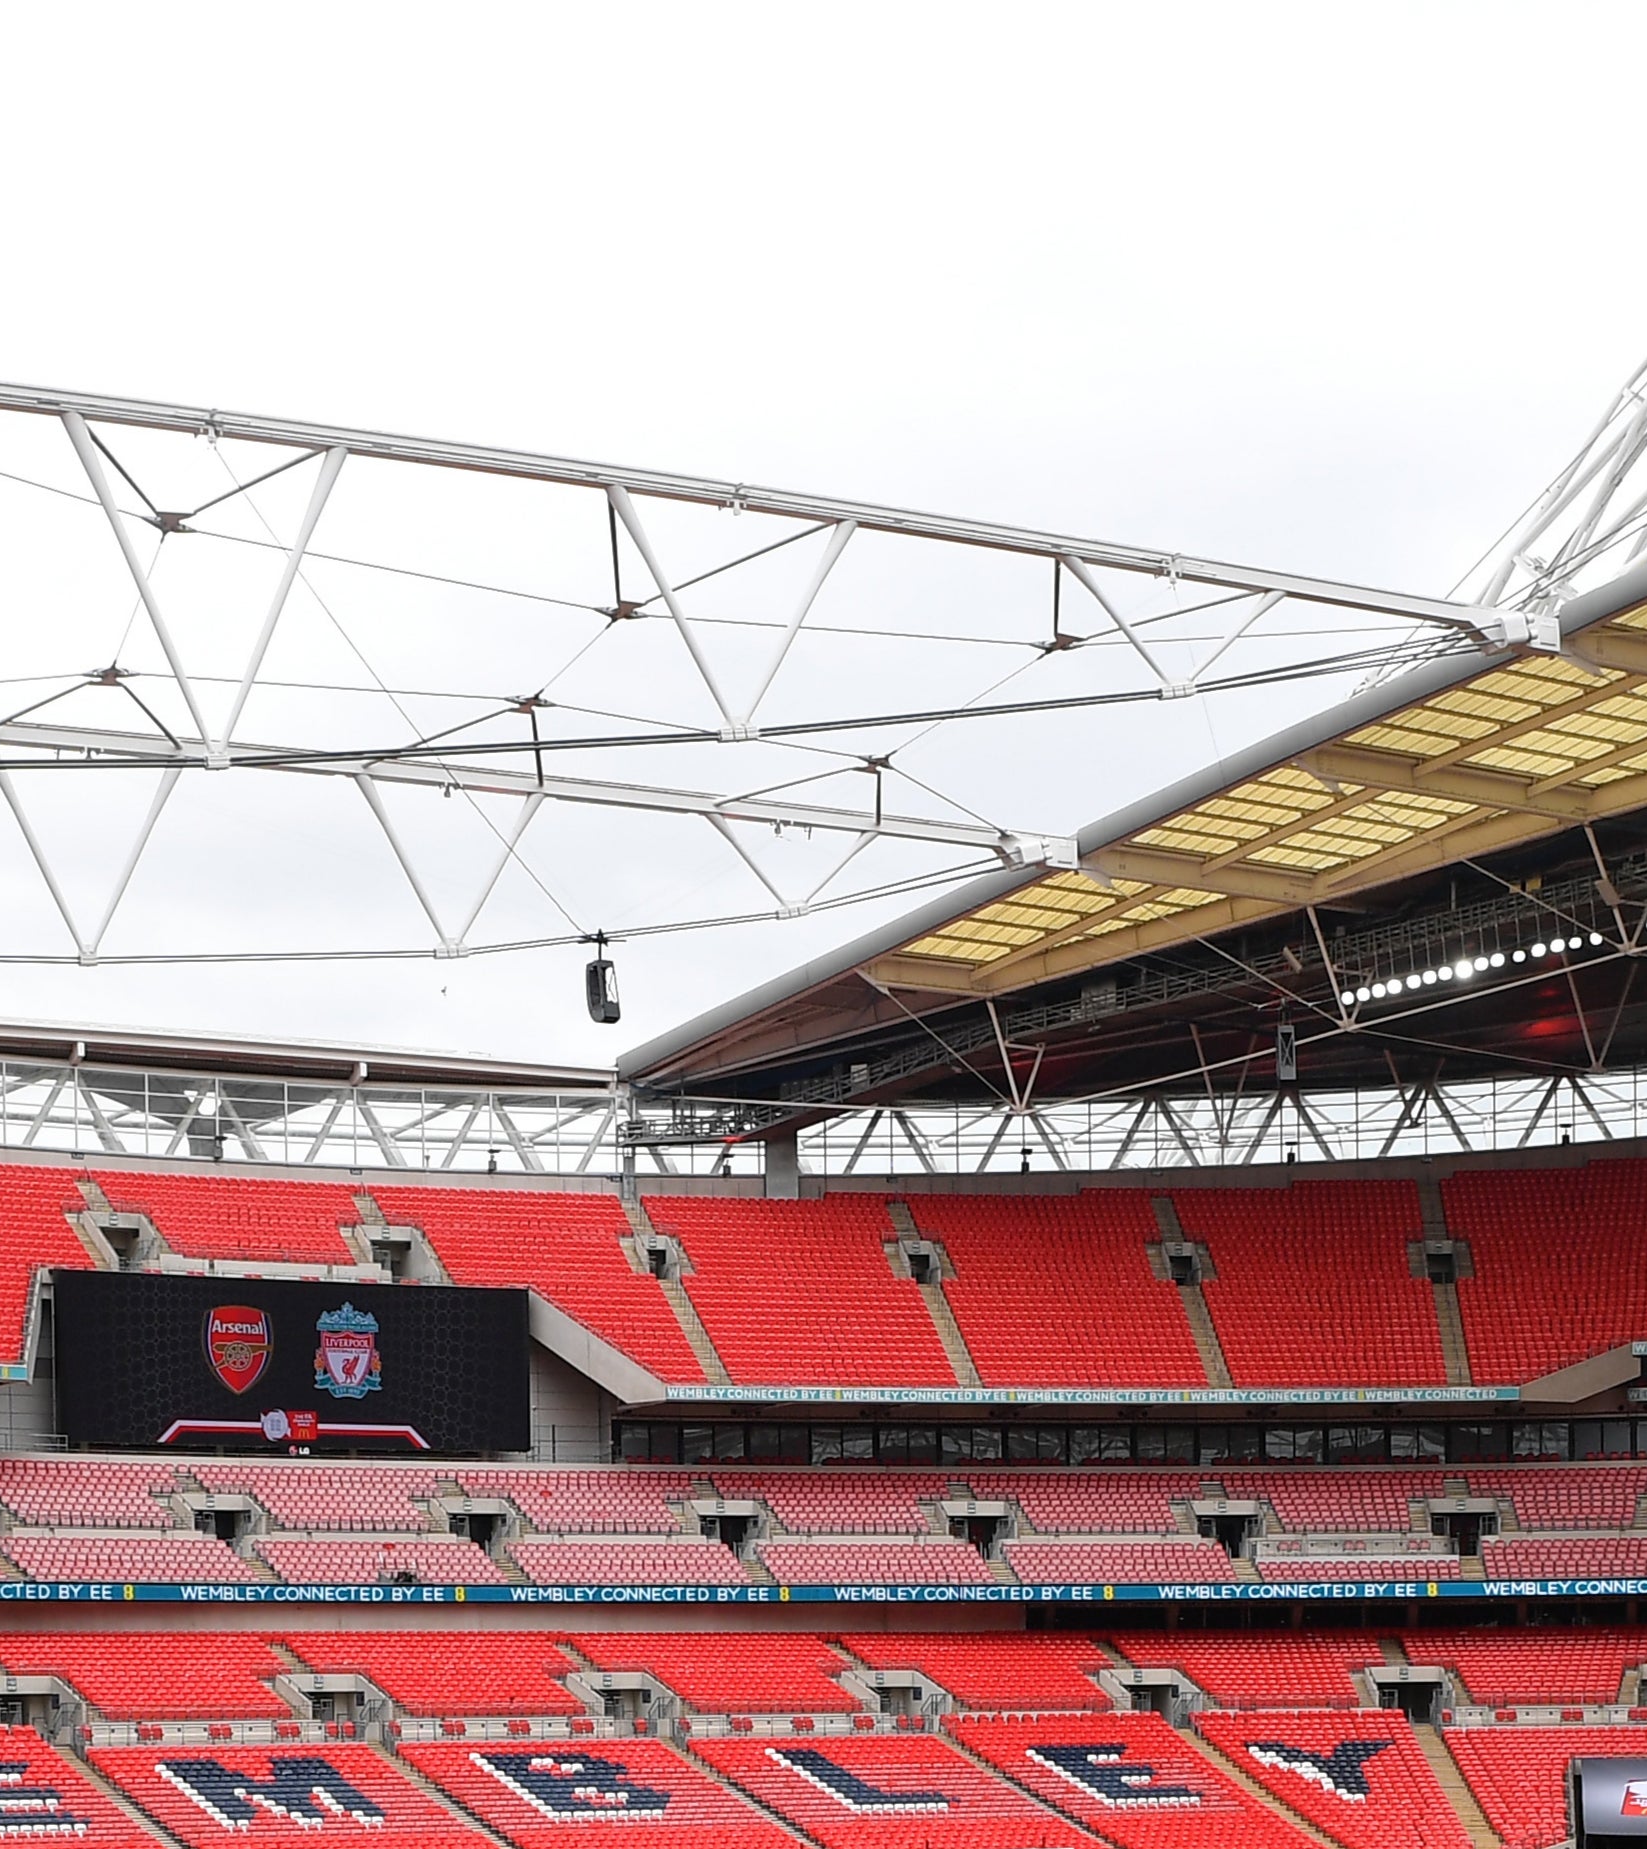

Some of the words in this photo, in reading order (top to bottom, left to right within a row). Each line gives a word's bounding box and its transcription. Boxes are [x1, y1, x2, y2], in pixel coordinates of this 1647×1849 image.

[212, 1320, 263, 1334] Arsenal
[325, 1338, 369, 1348] LIVERPOOL
[666, 1388, 725, 1399] WEMBLEY
[727, 1388, 798, 1399] CONNECTED
[841, 1389, 899, 1400] WEMBLEY
[901, 1390, 972, 1401] CONNECTED
[1015, 1391, 1073, 1401] WEMBLEY
[1076, 1391, 1146, 1401] CONNECTED
[1189, 1391, 1247, 1401] WEMBLEY
[1250, 1391, 1320, 1401] CONNECTED
[1364, 1389, 1422, 1400] WEMBLEY
[1424, 1388, 1496, 1400] CONNECTED
[58, 1584, 81, 1599] BY
[90, 1584, 112, 1600] EE
[179, 1585, 268, 1600] WEMBLEY
[272, 1586, 383, 1601] CONNECTED
[392, 1586, 414, 1601] BY
[423, 1587, 444, 1601] EE
[510, 1587, 596, 1601] WEMBLEY
[601, 1587, 709, 1601] CONNECTED
[717, 1587, 740, 1601] BY
[748, 1587, 768, 1601] EE
[832, 1587, 919, 1601] WEMBLEY
[924, 1586, 1034, 1600] CONNECTED
[1042, 1586, 1063, 1600] BY
[1072, 1586, 1092, 1600] EE
[1157, 1585, 1243, 1599] WEMBLEY
[1248, 1584, 1356, 1598] CONNECTED
[1364, 1583, 1386, 1597] BY
[1395, 1583, 1416, 1597] EE
[1482, 1581, 1570, 1596] WEMBLEY
